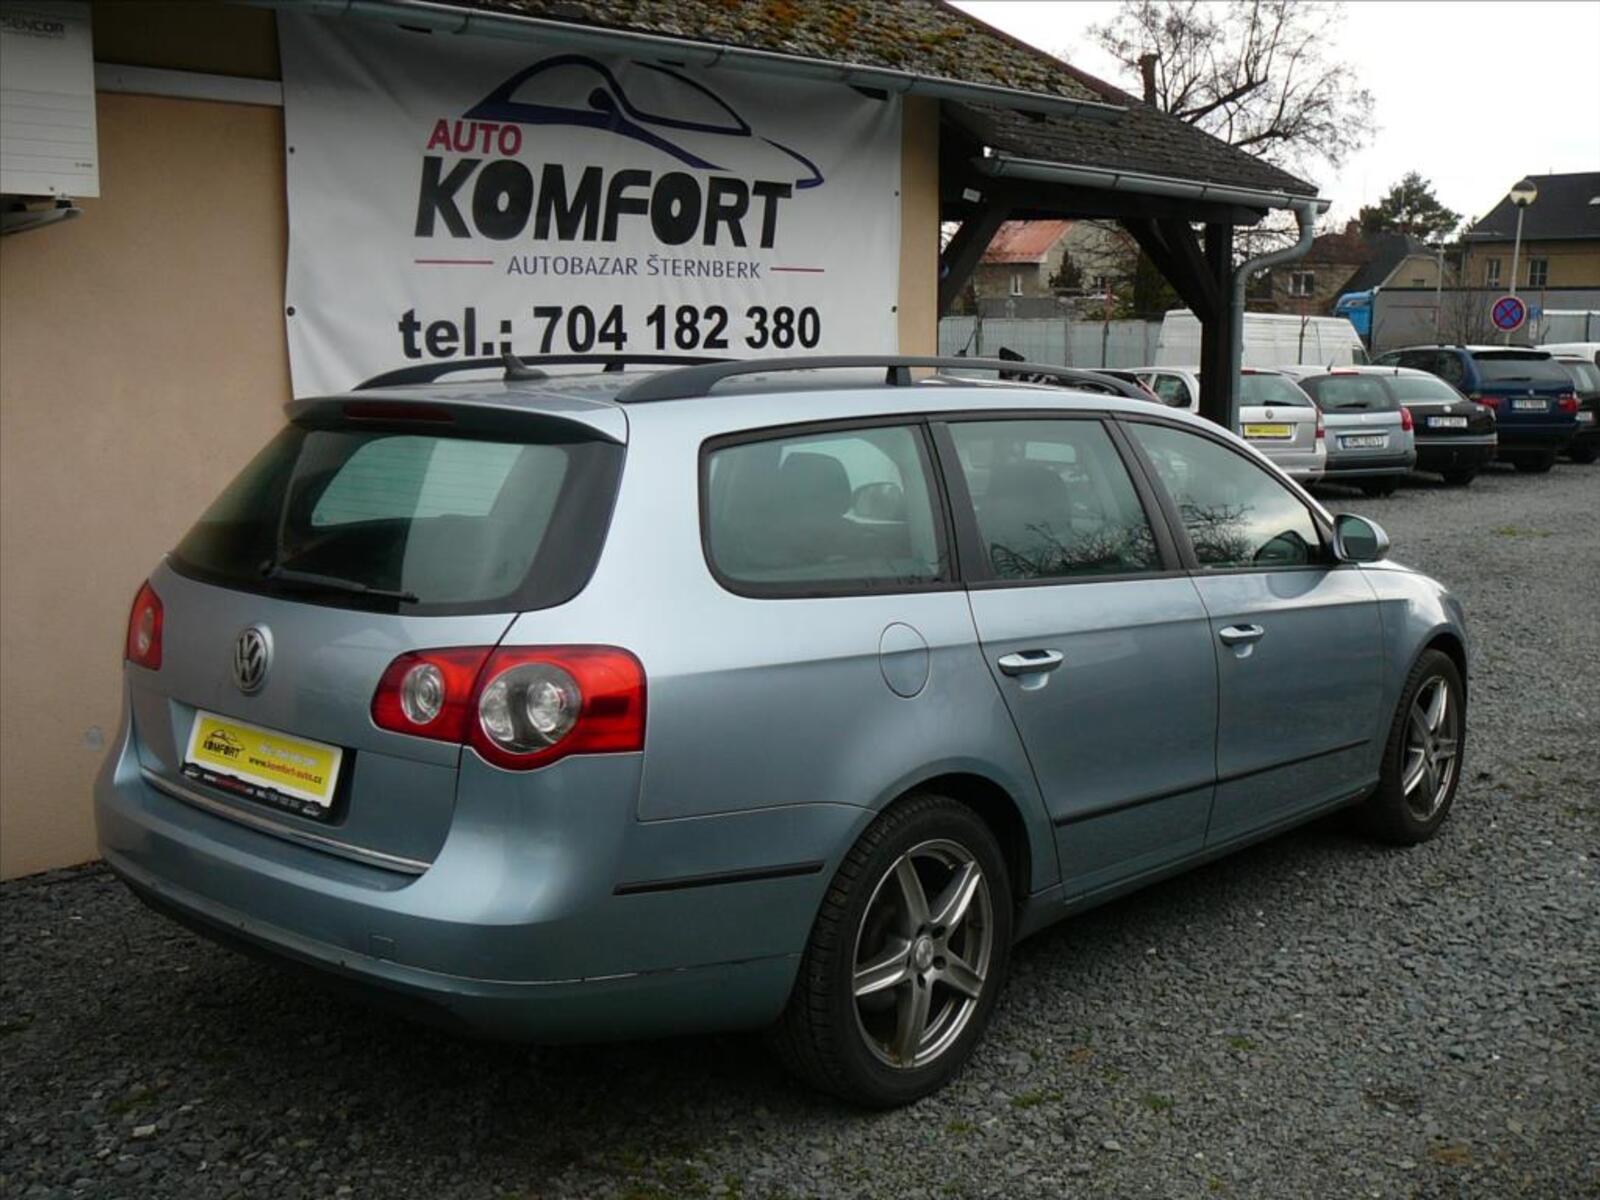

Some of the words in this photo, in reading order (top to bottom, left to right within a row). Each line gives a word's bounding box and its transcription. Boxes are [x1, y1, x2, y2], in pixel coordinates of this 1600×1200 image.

[427, 119, 523, 156] AUTO
[414, 155, 793, 249] KOMFORT
[506, 255, 638, 277] AUTOBAZAR
[645, 253, 762, 279] ŠTERNBERK
[398, 307, 512, 359] tel.:
[533, 304, 628, 354] 704
[646, 304, 729, 351] 182
[745, 305, 821, 350] 380
[203, 739, 240, 759] KOMFORT
